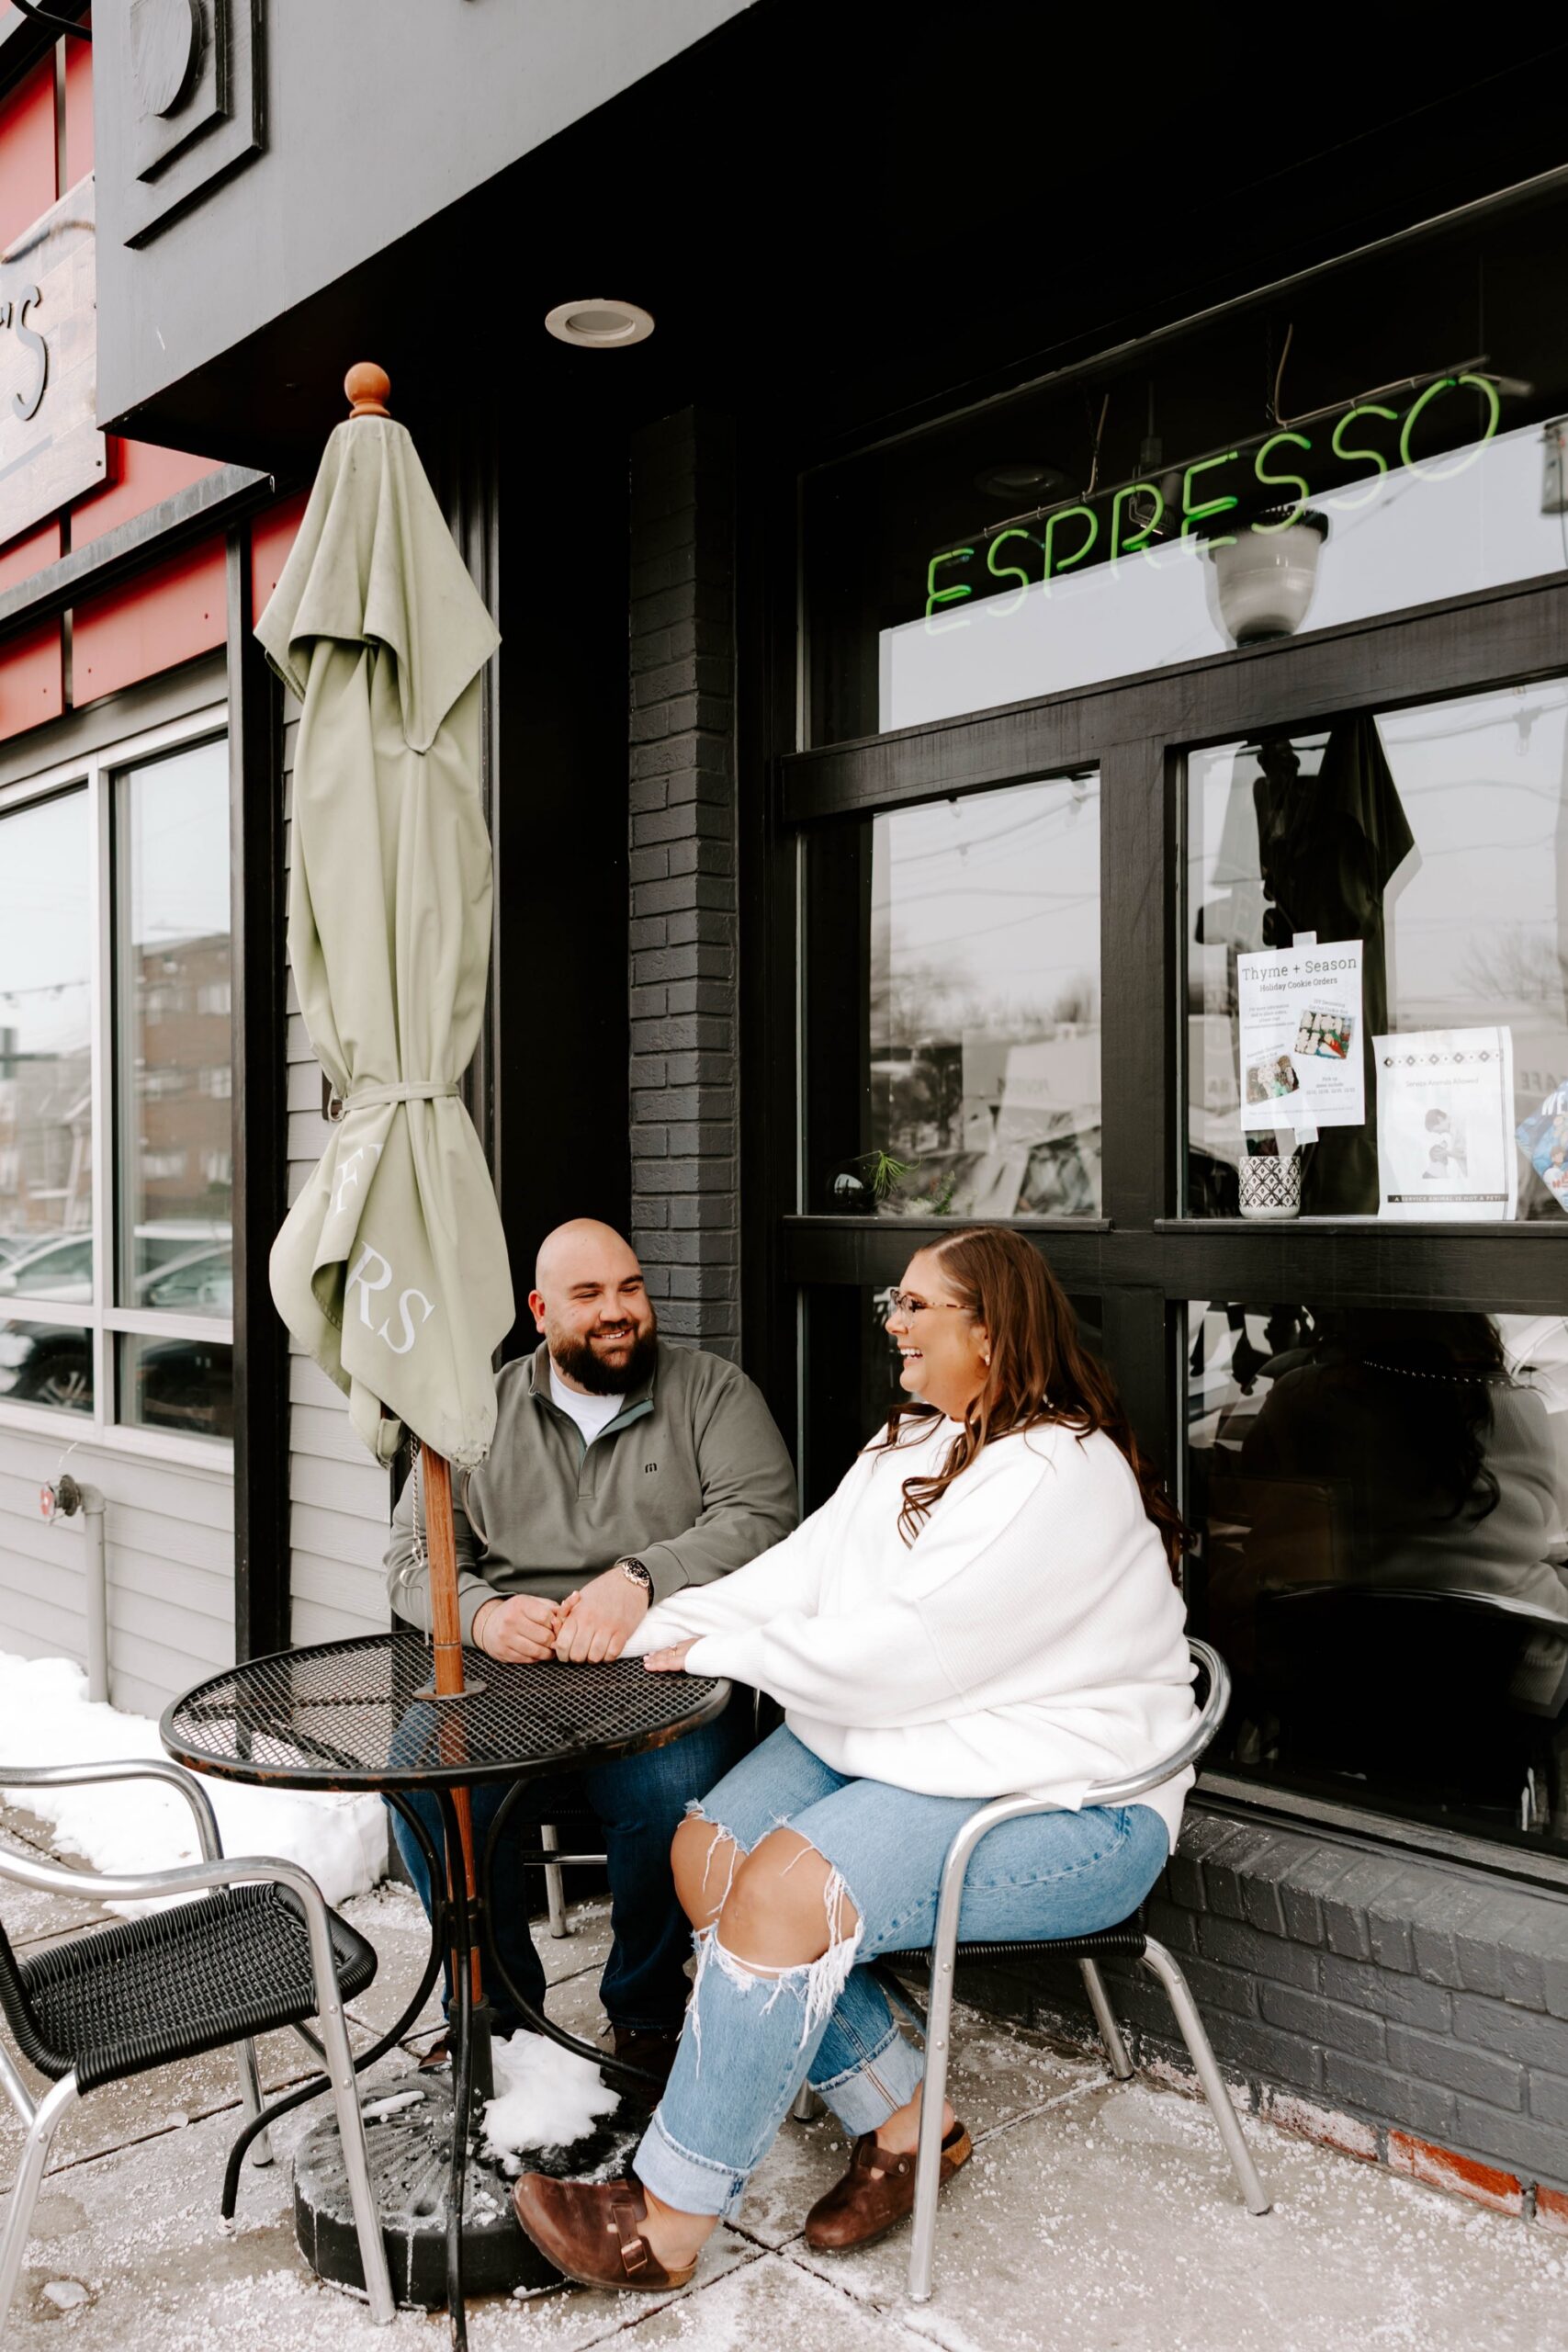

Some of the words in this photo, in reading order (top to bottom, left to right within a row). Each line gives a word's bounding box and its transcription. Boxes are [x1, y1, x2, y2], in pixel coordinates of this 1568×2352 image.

[924, 372, 1501, 636] ESPRESSO
[1242, 966, 1289, 981] Thyme
[1305, 958, 1357, 974] Season
[1259, 983, 1286, 992] Holiday
[1287, 979, 1312, 989] Cookie
[1313, 977, 1338, 986] Orders
[1405, 1080, 1427, 1088] Service
[1453, 1077, 1479, 1085] Allowed
